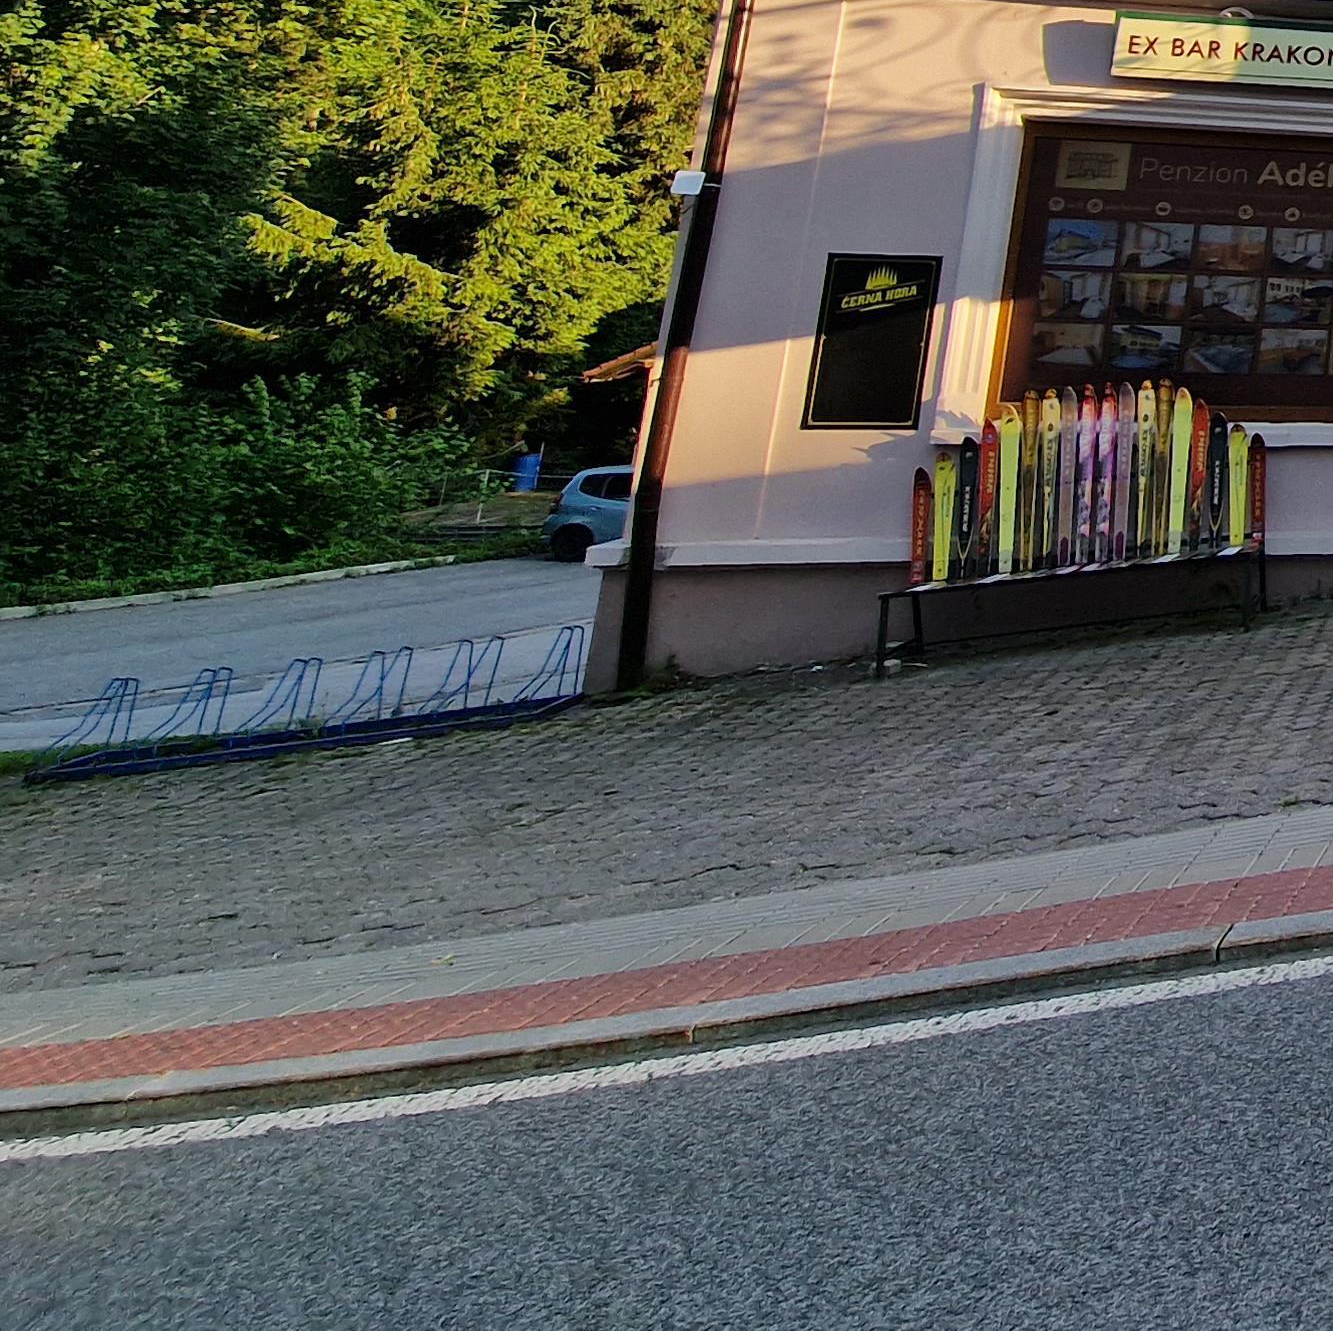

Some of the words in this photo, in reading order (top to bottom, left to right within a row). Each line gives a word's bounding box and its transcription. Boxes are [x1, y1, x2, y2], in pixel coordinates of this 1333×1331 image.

[1127, 35, 1159, 56] EX
[1171, 38, 1222, 59] BAR
[1139, 157, 1249, 184] Penzion
[884, 285, 917, 301] HORA
